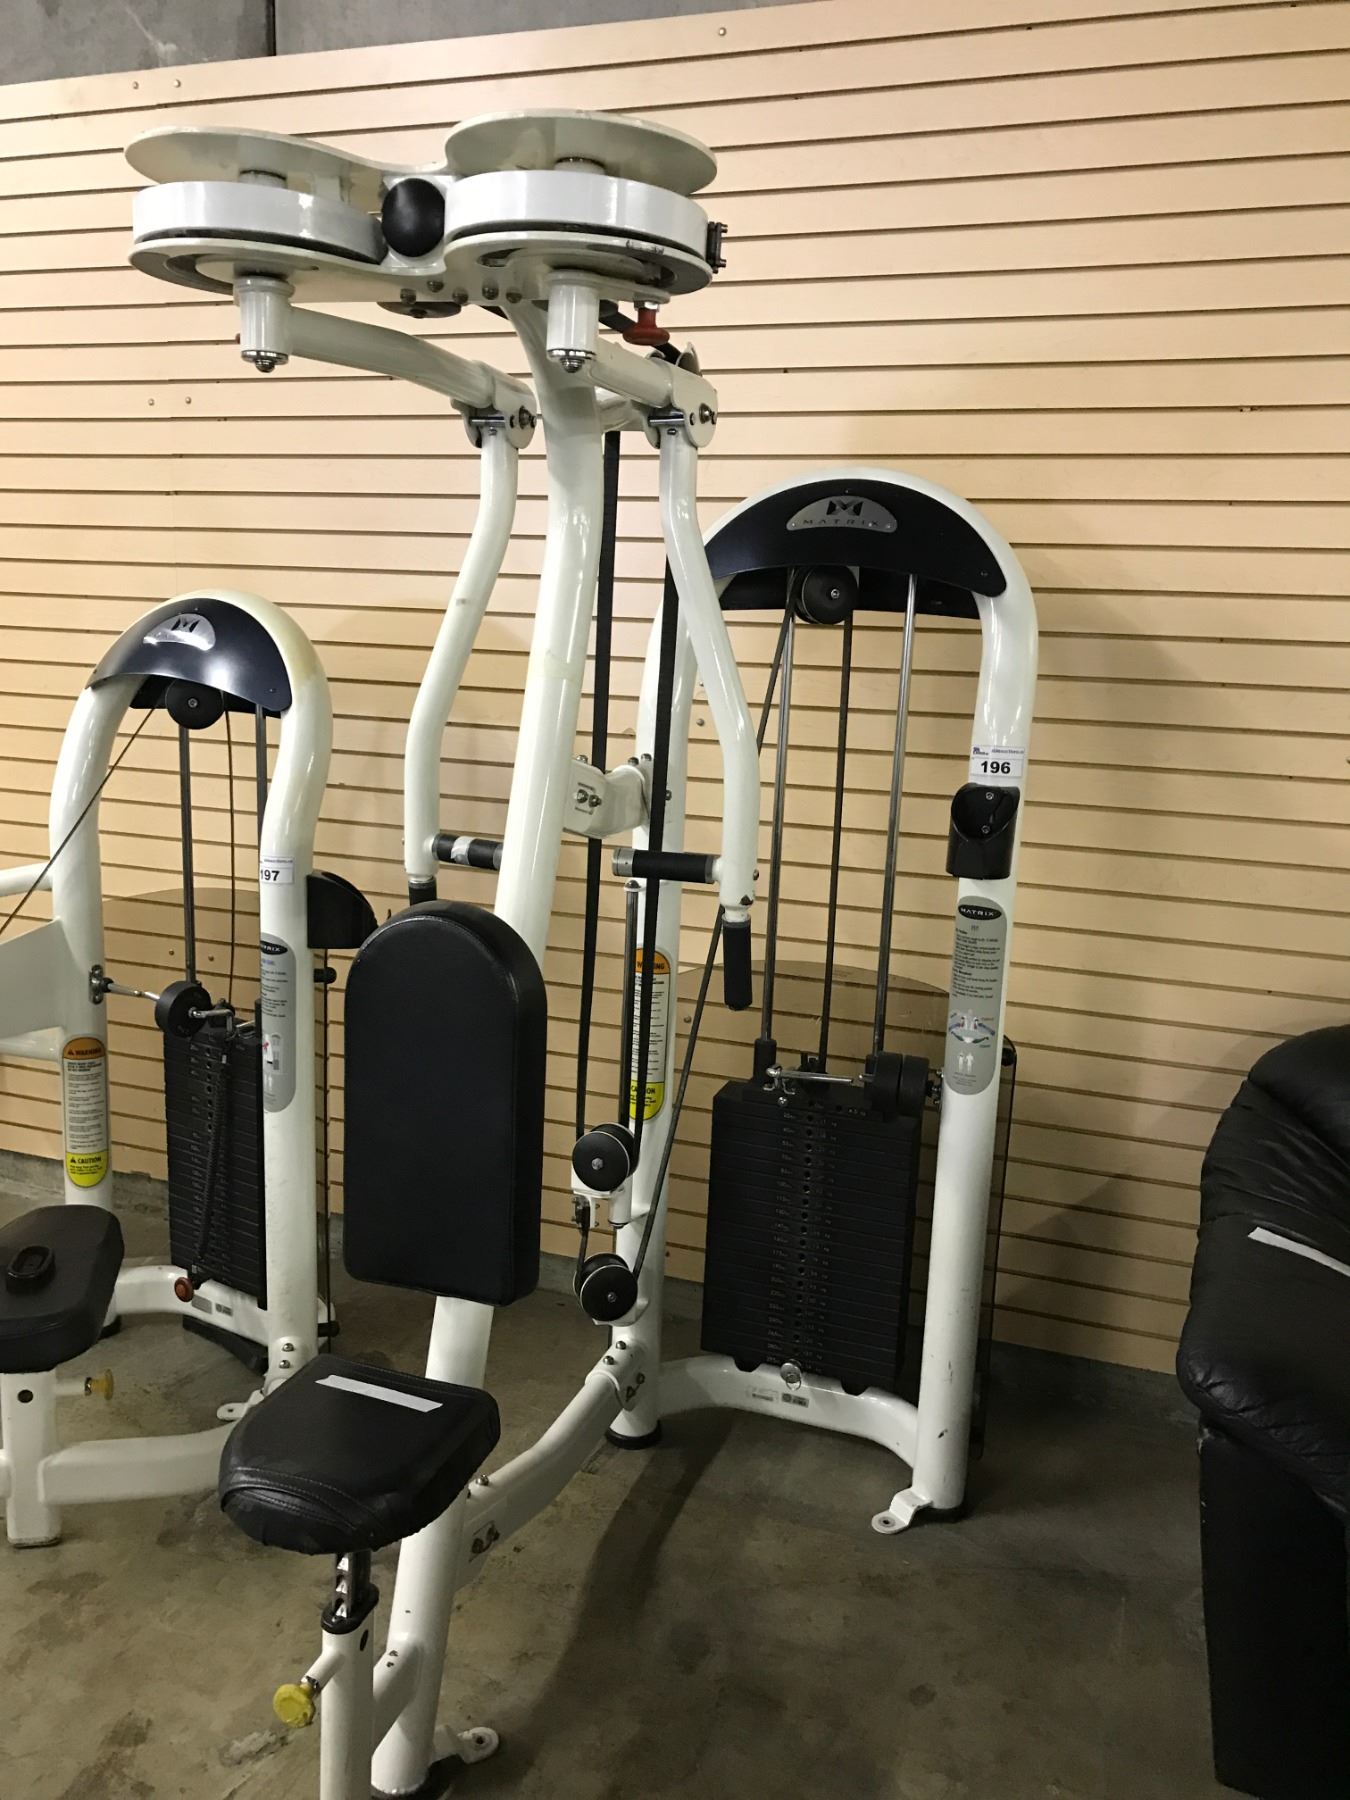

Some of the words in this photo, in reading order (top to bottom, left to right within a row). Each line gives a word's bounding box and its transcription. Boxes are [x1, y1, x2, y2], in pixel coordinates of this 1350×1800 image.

[801, 518, 880, 527] MATRIX
[981, 760, 1011, 774] 196
[960, 907, 995, 917] MATRIX
[77, 1156, 102, 1164] CAUTION
